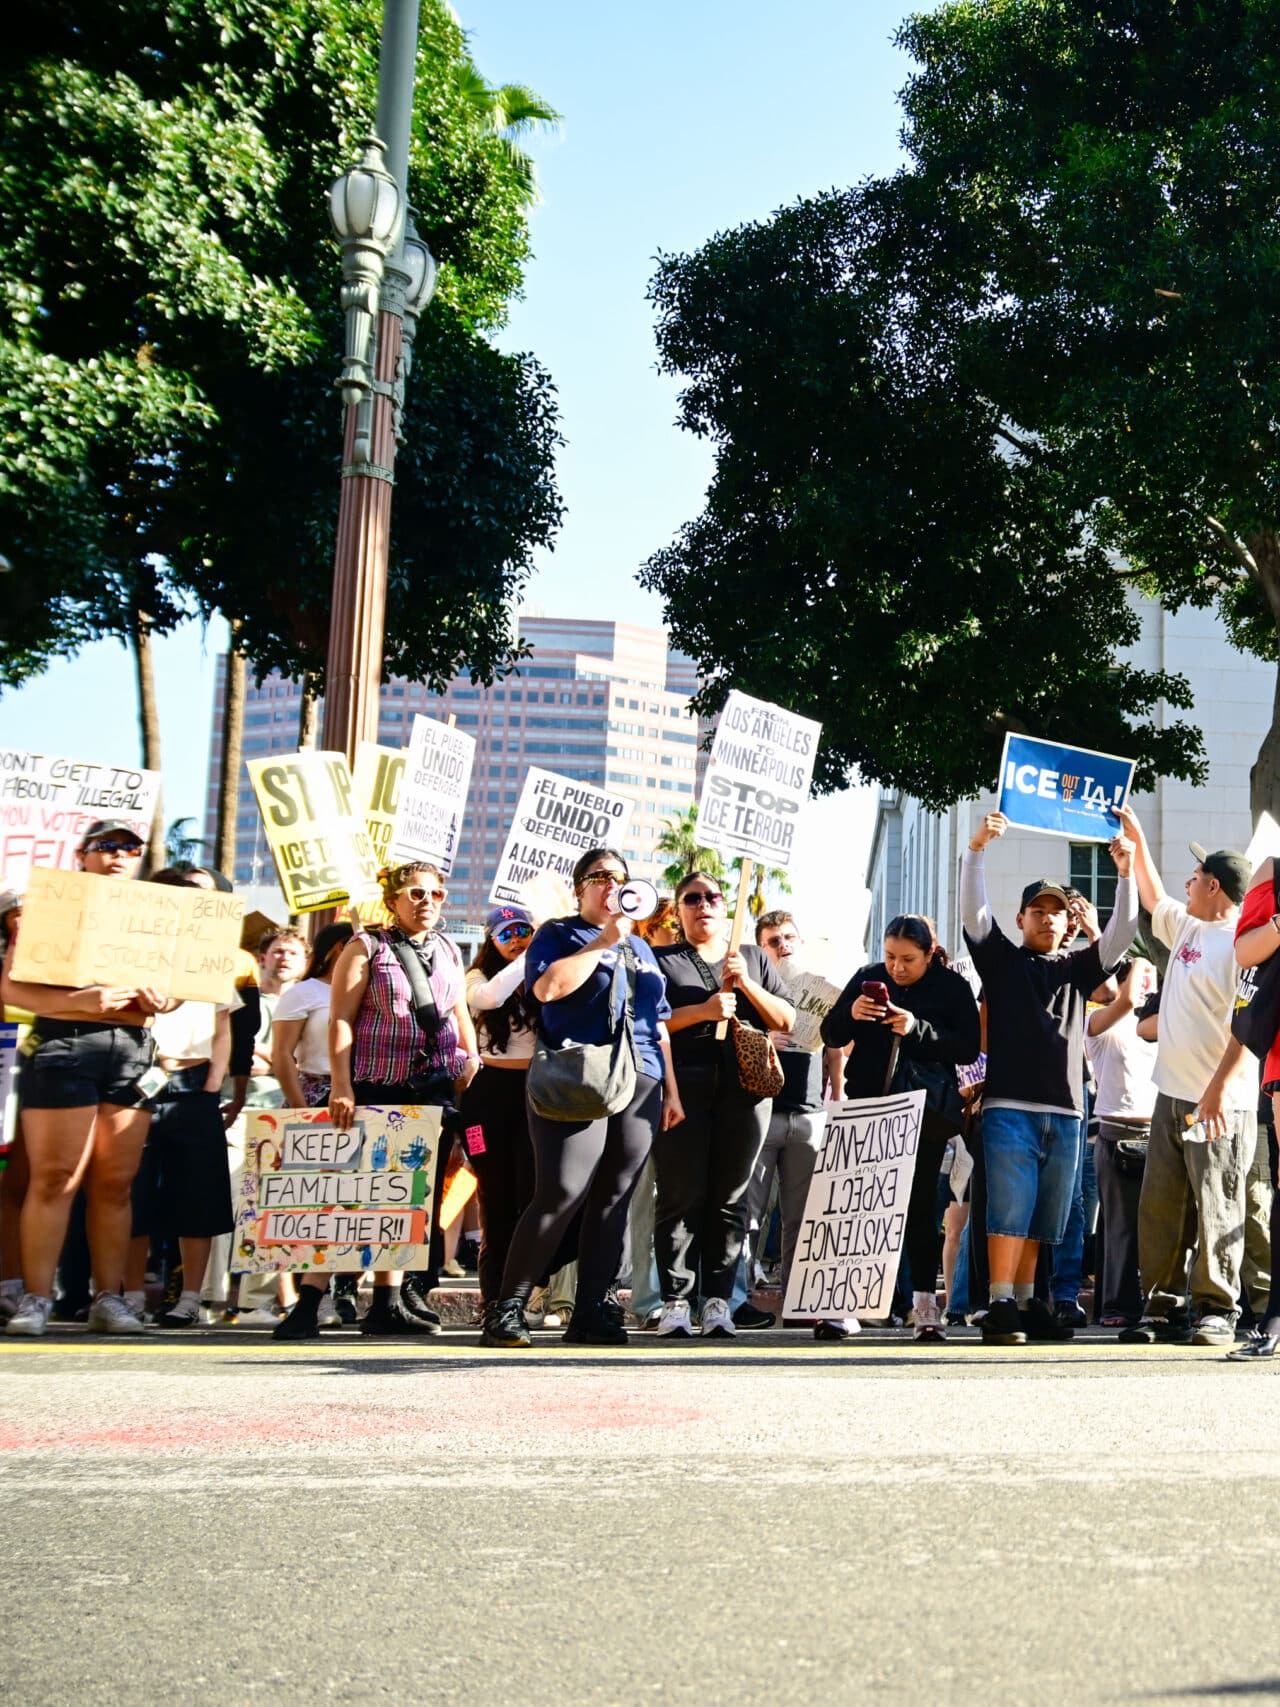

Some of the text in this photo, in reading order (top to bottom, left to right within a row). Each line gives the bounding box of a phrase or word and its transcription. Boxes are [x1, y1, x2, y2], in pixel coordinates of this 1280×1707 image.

[724, 703, 812, 757] LOS ANGELES
[751, 707, 790, 726] FROM
[421, 745, 464, 783] UNIDO
[716, 739, 805, 790] MINNEAPOLIS
[756, 743, 775, 756] TO
[2, 776, 66, 802] ABOUT
[50, 760, 102, 783] GET
[111, 768, 143, 790] TO
[1005, 761, 1060, 799] ICE
[1061, 773, 1080, 790] OUT
[533, 779, 624, 817] ¡EL PUEBLO
[709, 774, 800, 815] STOP
[1062, 789, 1074, 803] OF
[536, 796, 610, 838] UNIDO
[702, 796, 731, 828] ICE
[733, 805, 795, 849] TERROR
[279, 839, 315, 871] ICE
[509, 842, 518, 860] A
[520, 845, 546, 868] LAS
[42, 881, 246, 921] NO HUMAN BEING
[76, 910, 213, 942] IS ILLEGAL
[29, 941, 236, 977] ON STOLEN LAND
[291, 1132, 351, 1162] KEEP
[813, 1109, 921, 1175] RESISTANCE
[854, 1164, 878, 1176] OUR
[264, 1175, 408, 1206] FAMILIES
[822, 1168, 899, 1216] EXPECT
[272, 1213, 404, 1242] TOGETHER!!
[799, 1213, 905, 1262] EXISTENCE
[837, 1258, 863, 1267] OUR
[791, 1263, 886, 1313] RESPECT
